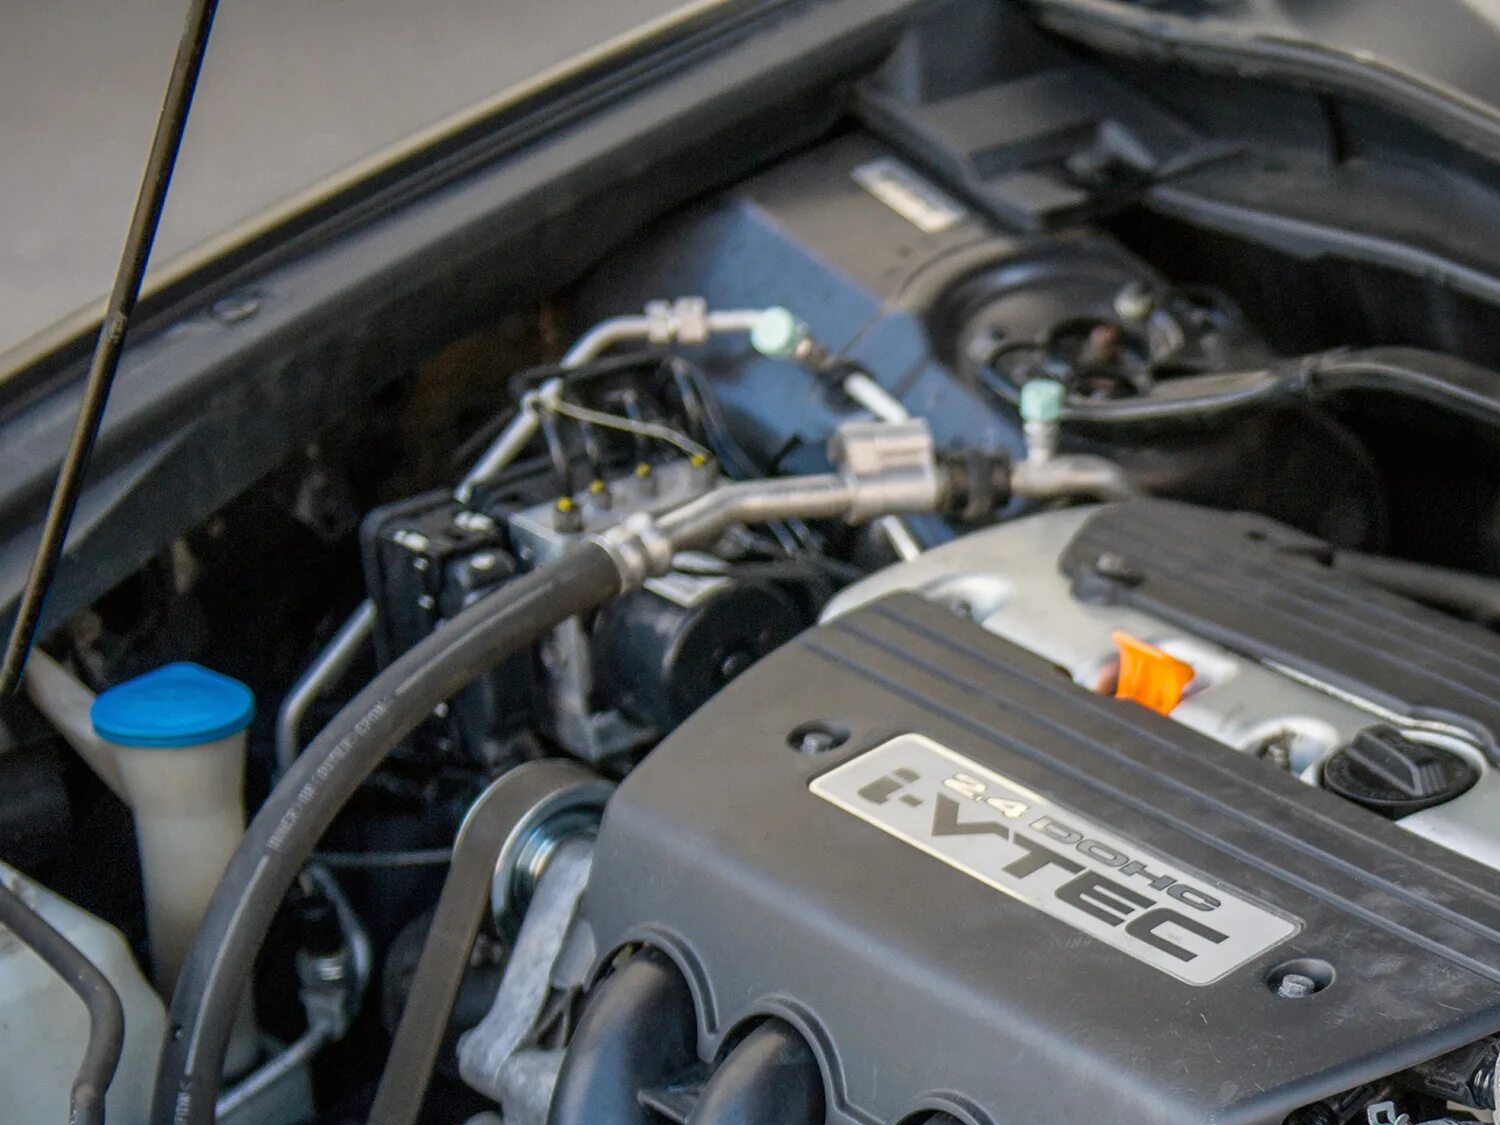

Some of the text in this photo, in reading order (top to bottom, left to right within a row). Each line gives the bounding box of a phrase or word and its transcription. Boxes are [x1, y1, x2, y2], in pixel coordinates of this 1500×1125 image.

[857, 767, 1231, 963] i-VTEC
[942, 772, 1223, 912] 2.4 DOHC
